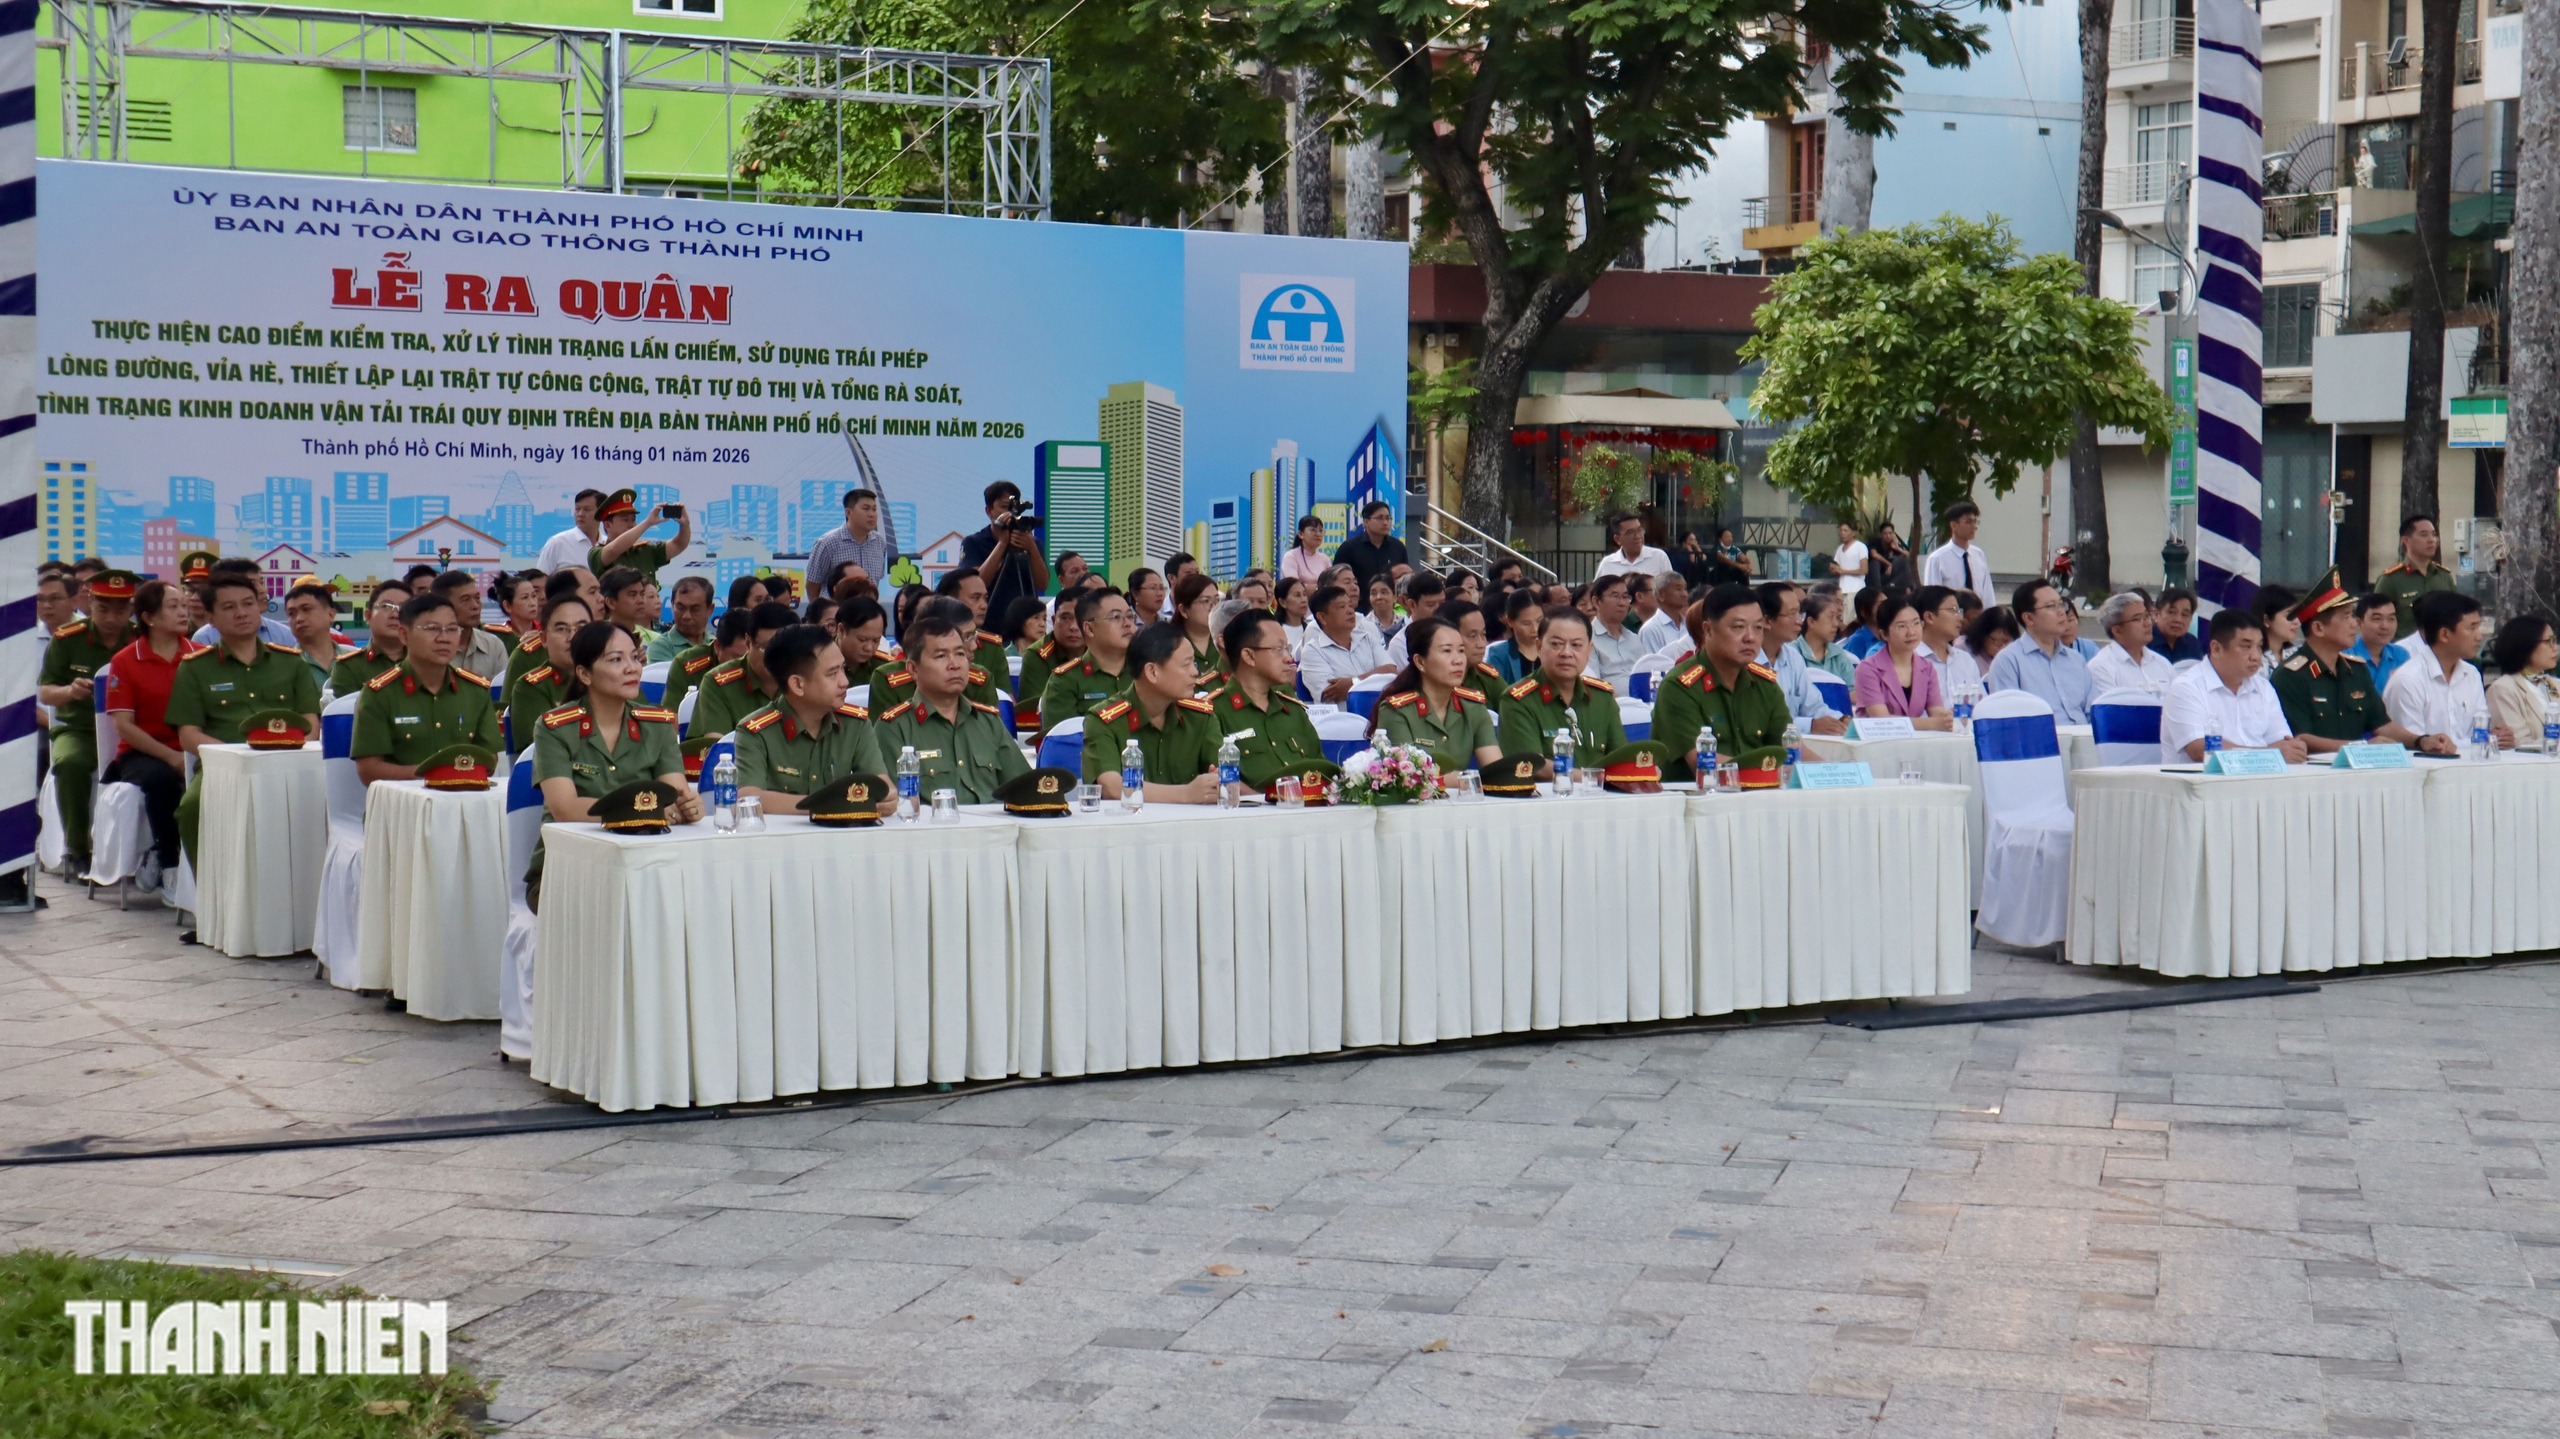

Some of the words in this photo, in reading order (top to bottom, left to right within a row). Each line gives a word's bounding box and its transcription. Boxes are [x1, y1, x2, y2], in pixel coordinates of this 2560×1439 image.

[214, 216, 284, 233] BAN
[295, 221, 340, 236] AN
[352, 223, 441, 241] TOÀN
[452, 230, 531, 246] GIAO
[541, 231, 650, 252] THÔNG
[660, 239, 760, 259] THÀNH
[230, 193, 299, 211] BAN
[312, 198, 403, 217] NHÂN
[416, 202, 481, 221] DÂN
[493, 207, 599, 228] THÀNH
[737, 221, 784, 238] CHÍ
[794, 226, 863, 242] MINH
[331, 251, 421, 311] LỄ
[444, 273, 537, 314] RA
[559, 273, 732, 323] QUÂN
[91, 320, 150, 344] THỰC
[158, 320, 210, 346] HIỆN
[218, 325, 260, 345] CAO
[268, 321, 323, 347] ĐIỂM
[330, 323, 384, 349] KIỂM
[391, 331, 436, 353] TRA,
[442, 329, 472, 352] XỬ
[477, 332, 500, 353] LÝ
[506, 334, 552, 355] TÌNH
[558, 338, 624, 361] TRẠNG
[631, 336, 668, 359] LẤN
[675, 339, 742, 364] CHIẾM,
[748, 341, 776, 363] SỬ
[779, 346, 829, 368] DỤNG
[835, 347, 876, 367] TRÁI
[881, 348, 928, 369] PHÉP
[1252, 352, 1277, 361] THÀNH
[1310, 355, 1322, 363] CHÍ
[1280, 343, 1299, 351] TOÀN
[1302, 344, 1318, 352] GIAO
[1321, 345, 1345, 353] THÔNG
[48, 353, 107, 377] LÒNG
[115, 356, 199, 382] ĐƯỜNG,
[207, 357, 242, 382] VỈA
[250, 361, 283, 385] HÈ,
[290, 361, 348, 385] THIẾT
[356, 364, 395, 389] LẬP
[402, 369, 434, 391] LẠI
[440, 368, 490, 392] TRẬT
[497, 371, 522, 394] TỰ
[528, 370, 583, 392] CÔNG
[589, 372, 649, 397] CỘNG,
[655, 374, 702, 399] TRẬT
[708, 378, 733, 400] TỰ
[737, 377, 762, 397] ĐÔ
[768, 381, 796, 402] THỊ
[802, 380, 826, 400] VÀ
[831, 377, 879, 401] TỔNG
[885, 382, 909, 402] RÀ
[915, 383, 962, 406] SOÁT,
[36, 391, 89, 414] TÌNH
[96, 397, 171, 420] TRẠNG
[179, 399, 232, 419] KINH
[240, 401, 314, 421] DOANH
[321, 400, 364, 425] VẬN
[370, 399, 402, 424] TẢI
[409, 403, 455, 424] TRÁI
[462, 407, 502, 427] QUY
[508, 408, 557, 430] ĐỊNH
[563, 407, 614, 428] TRÊN
[620, 411, 653, 432] ĐỊA
[659, 409, 699, 430] BÀN
[705, 411, 767, 432] THÀNH
[773, 411, 812, 433] PHỐ
[817, 412, 841, 434] HỒ
[847, 415, 877, 435] CHÍ
[883, 419, 930, 436] MINH
[936, 418, 977, 437] NĂM
[982, 422, 1025, 438] 2026
[302, 438, 358, 455] Thành
[365, 437, 399, 459] phố
[405, 438, 429, 457] Hồ
[435, 441, 464, 458] Chí
[470, 442, 517, 461] Minh,
[523, 445, 564, 463] ngày
[571, 445, 590, 461] 16
[595, 446, 642, 464] tháng
[648, 446, 666, 462] 01
[672, 447, 707, 462] năm
[713, 448, 750, 463] 2026
